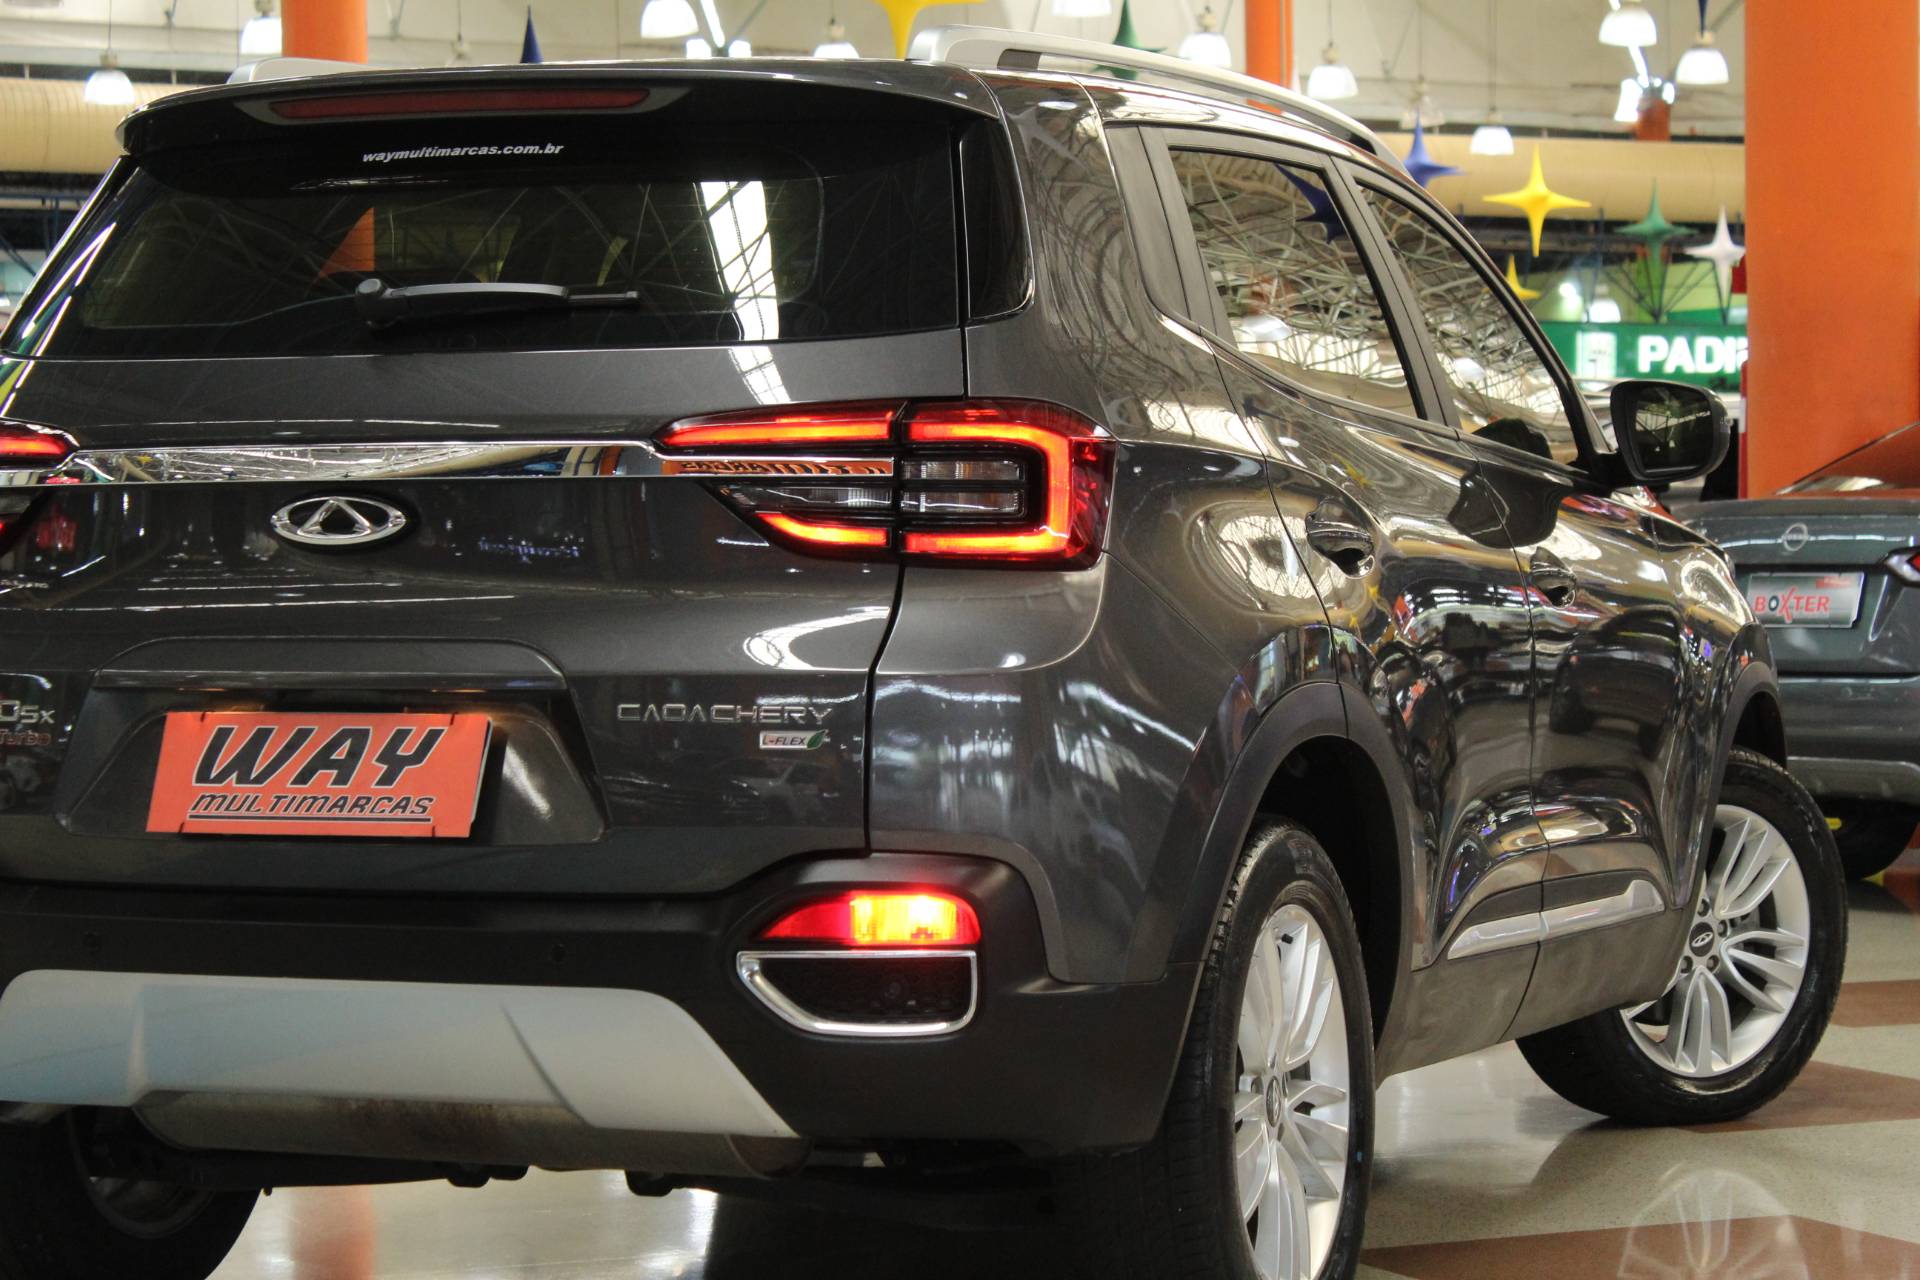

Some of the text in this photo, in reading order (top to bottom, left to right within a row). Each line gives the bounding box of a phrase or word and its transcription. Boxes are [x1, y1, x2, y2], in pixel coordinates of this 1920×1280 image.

[362, 143, 564, 163] waymultimarcas.com.br
[1754, 586, 1830, 624] BOXTER
[192, 726, 447, 788] WAY
[190, 793, 435, 816] MULTIMARCAS
